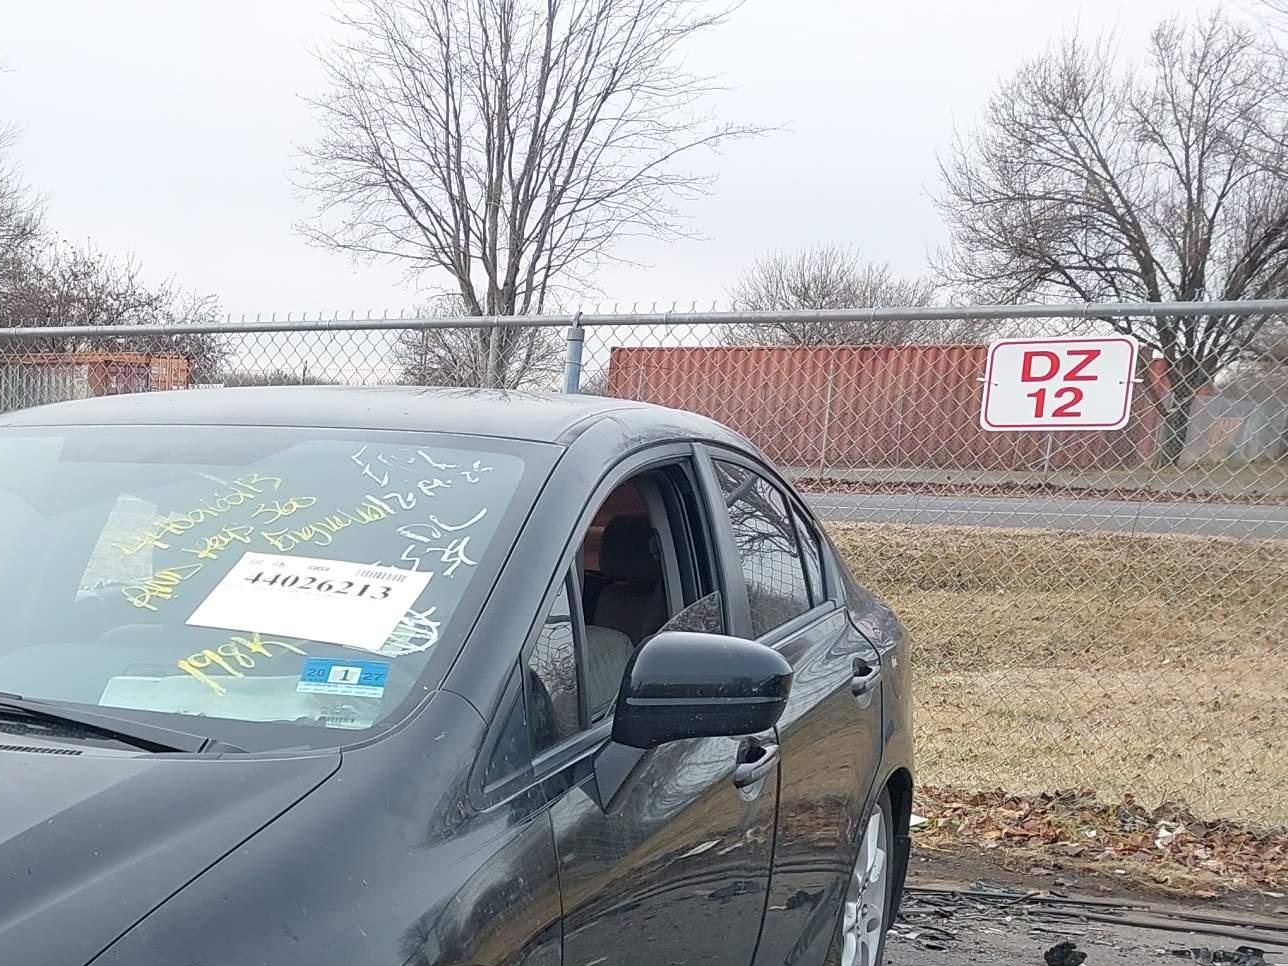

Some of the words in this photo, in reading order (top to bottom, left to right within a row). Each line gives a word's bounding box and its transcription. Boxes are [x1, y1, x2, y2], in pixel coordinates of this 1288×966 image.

[1021, 350, 1101, 382] DZ
[1027, 387, 1083, 417] 12
[244, 571, 392, 600] 44026213
[307, 668, 325, 677] 20
[339, 669, 349, 681] 1
[363, 672, 384, 681] 27
